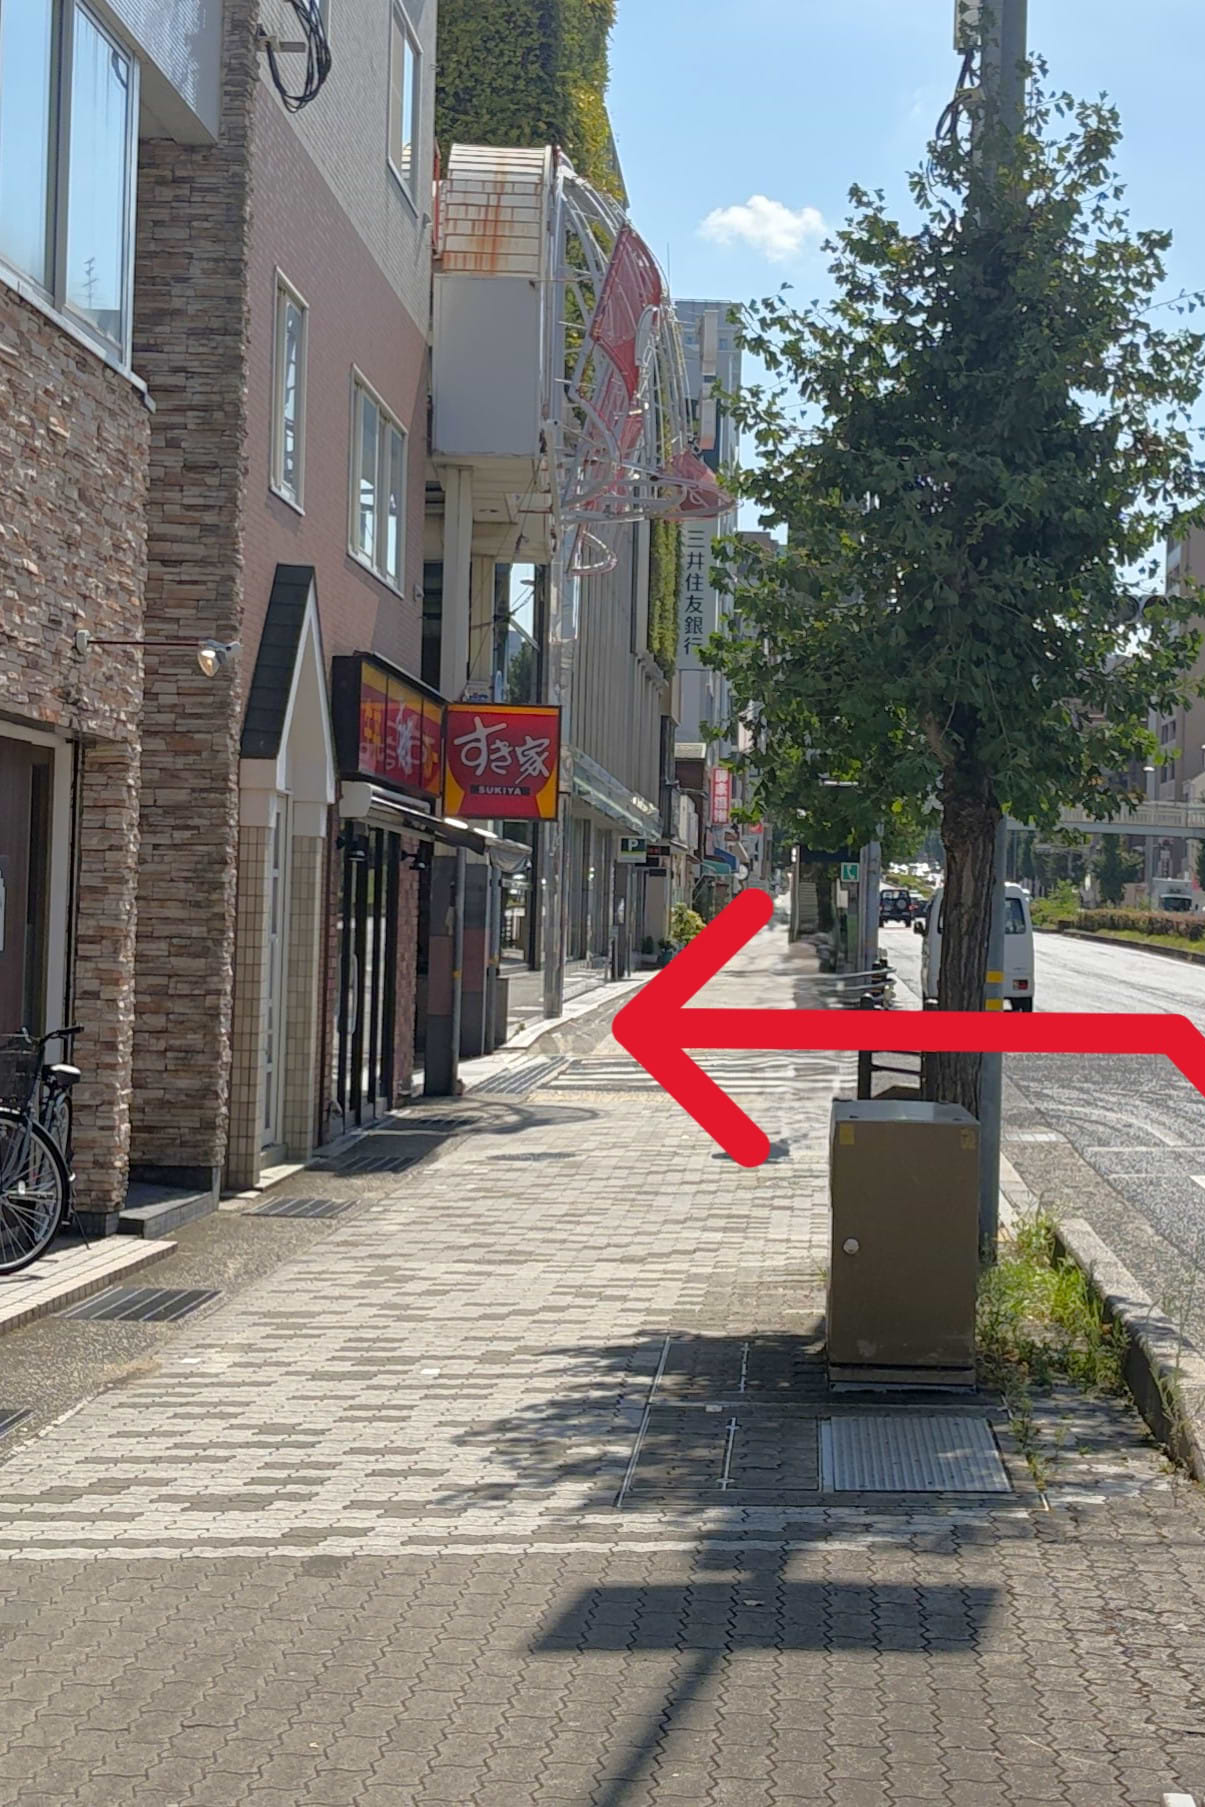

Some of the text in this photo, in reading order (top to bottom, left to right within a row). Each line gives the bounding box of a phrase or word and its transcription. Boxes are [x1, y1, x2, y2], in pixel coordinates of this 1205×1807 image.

[683, 529, 705, 656] 三井住友銀行
[453, 715, 551, 785] すき家
[478, 785, 523, 796] SUKIYA
[628, 839, 639, 852] P
